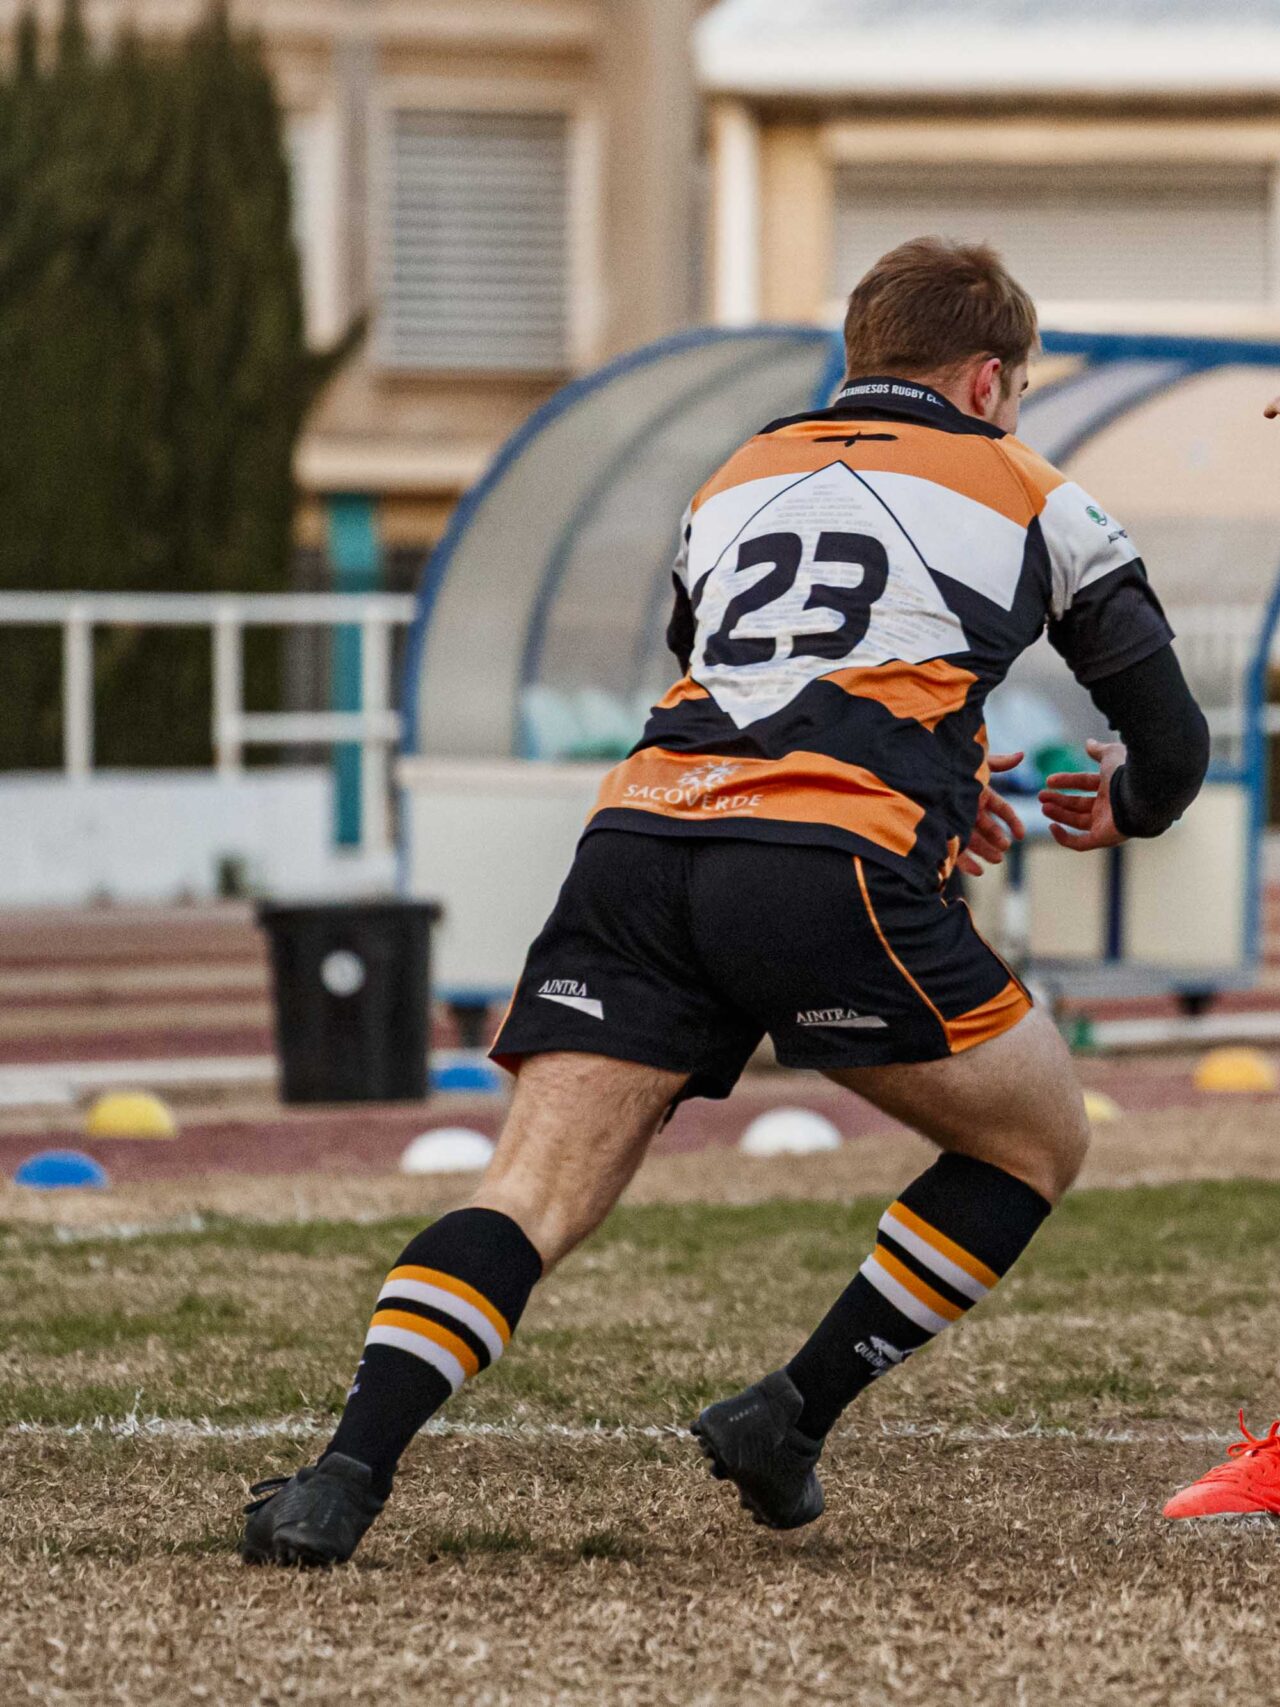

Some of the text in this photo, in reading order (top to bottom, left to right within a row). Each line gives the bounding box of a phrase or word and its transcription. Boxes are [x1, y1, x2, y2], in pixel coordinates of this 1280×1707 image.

[839, 383, 889, 399] TAHUESOS
[891, 385, 924, 399] RUGBY
[703, 531, 889, 666] 23
[623, 784, 764, 811] SACOVERDE
[537, 979, 587, 997] AINTRA
[797, 1007, 859, 1023] AINTRA
